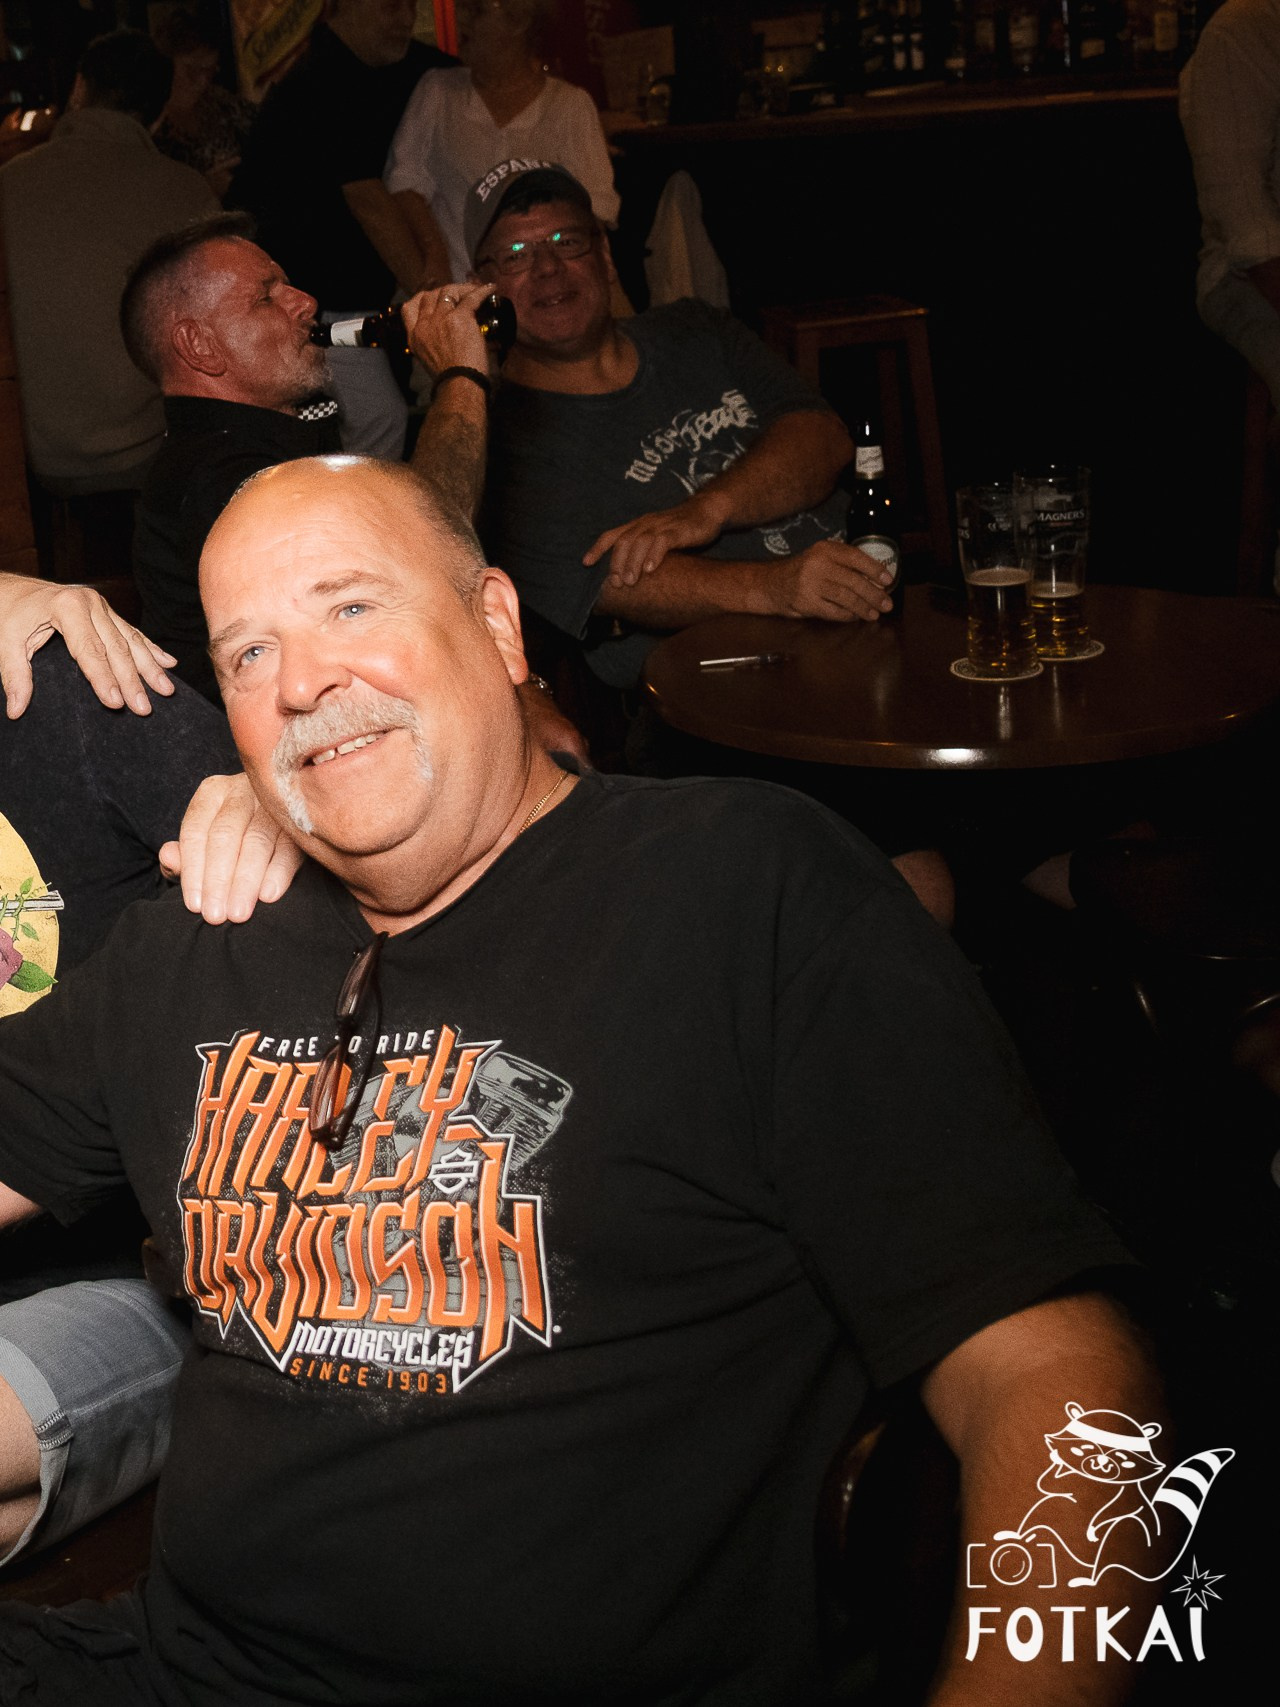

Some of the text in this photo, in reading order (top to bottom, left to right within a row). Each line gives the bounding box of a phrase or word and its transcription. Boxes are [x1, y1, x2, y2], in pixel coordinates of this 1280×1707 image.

[257, 1035, 320, 1058] FREE
[375, 1029, 436, 1055] RIDE
[182, 1141, 545, 1363] DAVIDSON
[291, 1320, 475, 1369] MOTORCYCLES
[289, 1356, 451, 1395] SINCE 1903
